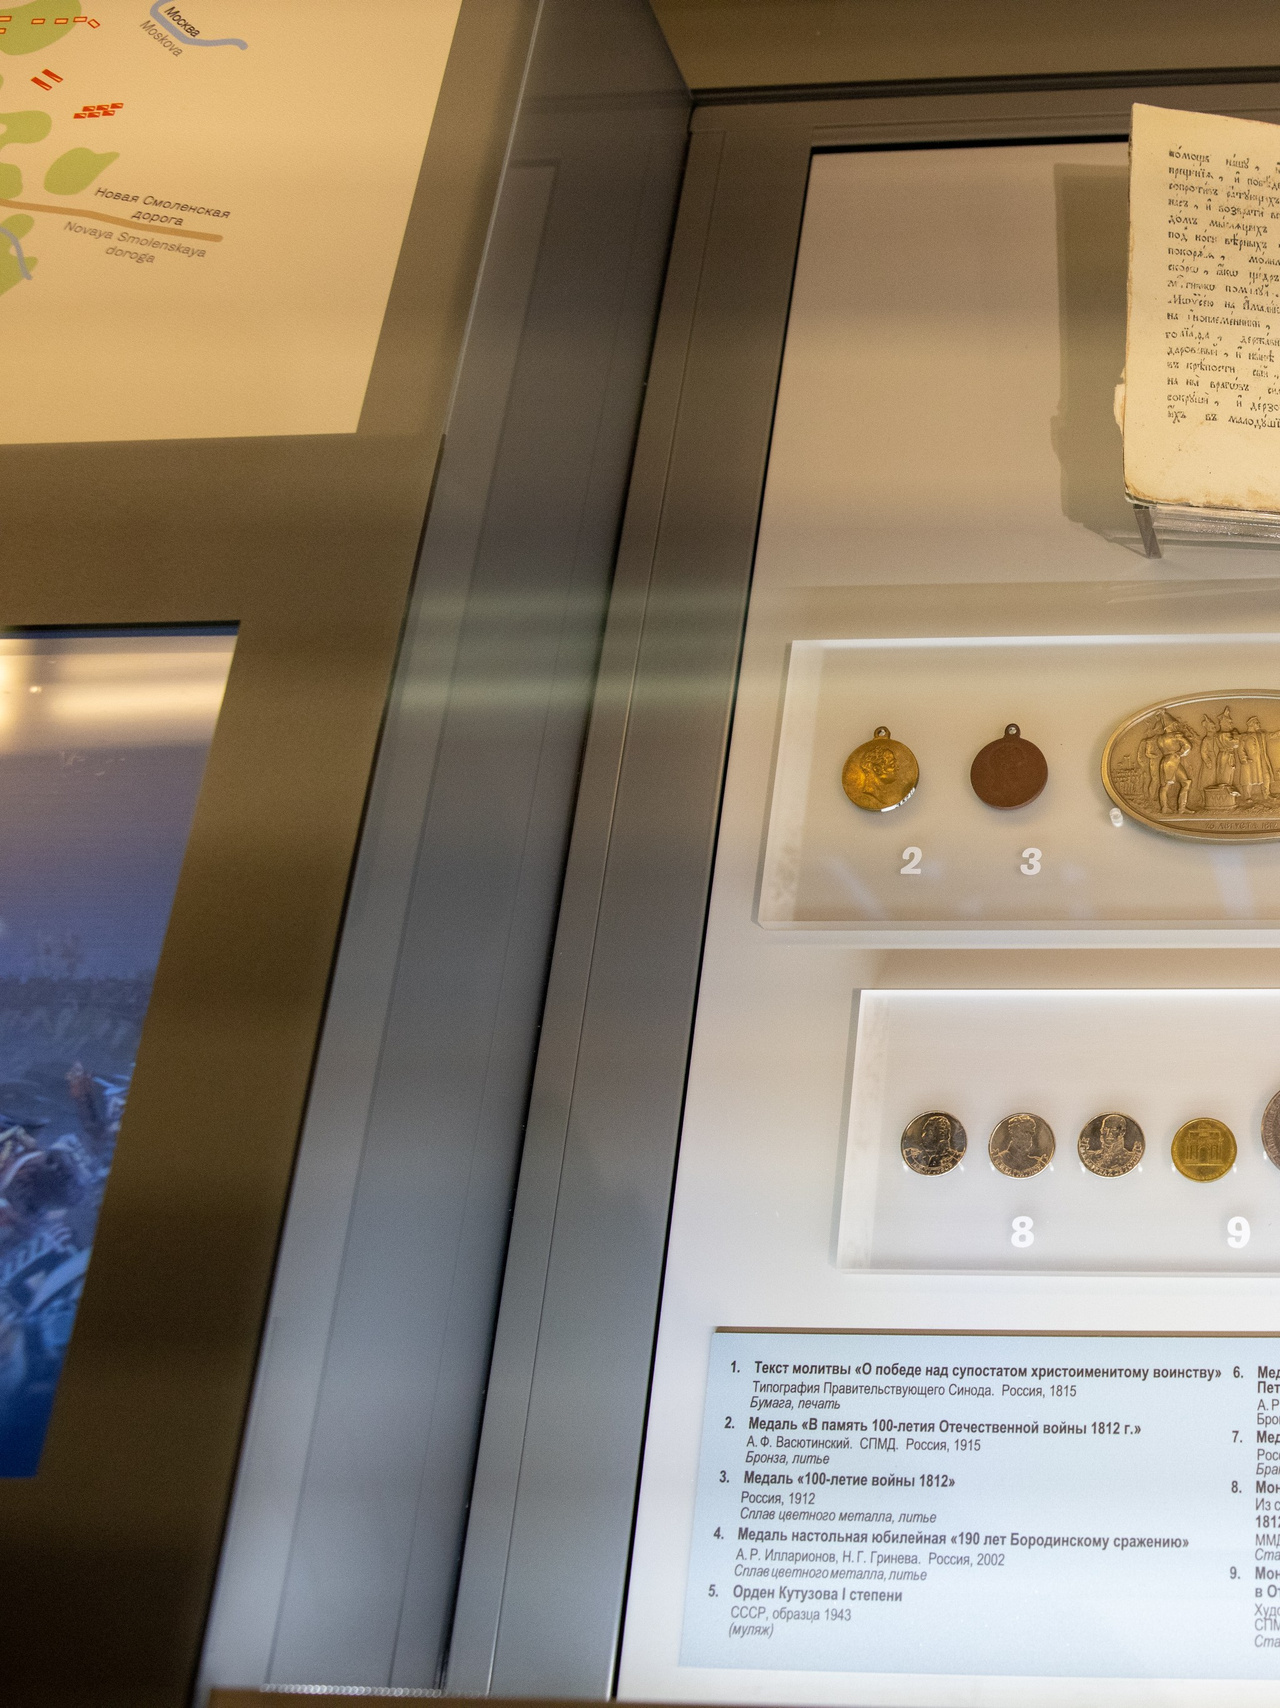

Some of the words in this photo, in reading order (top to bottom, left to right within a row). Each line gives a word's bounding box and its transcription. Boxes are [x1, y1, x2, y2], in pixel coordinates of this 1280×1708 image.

[164, 6, 200, 37] Москва
[140, 20, 182, 57] Moskova
[94, 187, 140, 202] Новая
[143, 195, 231, 219] Смоленская
[131, 210, 184, 226] дорога
[63, 221, 114, 240] Novaya
[117, 231, 207, 258] Smolenskaya
[105, 246, 155, 264] doroga
[901, 847, 922, 874] 2
[1021, 848, 1042, 875] 3
[1011, 1216, 1034, 1248] 8
[1228, 1217, 1250, 1248] 9
[730, 1360, 741, 1373] 1.
[754, 1360, 790, 1374] Текст
[792, 1364, 851, 1375] молитвы
[854, 1362, 872, 1376] «О
[875, 1362, 922, 1378] победе
[925, 1366, 949, 1379] над
[952, 1366, 1028, 1380] супостатом
[1030, 1367, 1150, 1382] христоименитому
[1153, 1368, 1222, 1382] воинству»
[1232, 1365, 1244, 1379] 6.
[752, 1380, 820, 1397] Типография
[823, 1381, 946, 1399] Правительствующего
[948, 1383, 995, 1398] Синода.
[1001, 1383, 1046, 1399] Россия,
[1050, 1384, 1077, 1398] 1815
[749, 1395, 794, 1411] Бумага,
[797, 1399, 841, 1410] печать
[724, 1415, 735, 1429] 2.
[748, 1416, 798, 1432] Медаль
[801, 1417, 818, 1431] «В
[821, 1421, 868, 1432] память
[872, 1418, 935, 1433] 100-летия
[939, 1419, 1039, 1434] Отечественной
[1043, 1421, 1087, 1435] войны
[1091, 1421, 1121, 1435] 1812
[1124, 1424, 1142, 1435] г.»
[719, 1469, 730, 1484] 3.
[743, 1470, 794, 1487] Медаль
[797, 1471, 868, 1486] «100-летие
[871, 1473, 915, 1487] войны
[919, 1473, 956, 1488] 1812»
[1231, 1480, 1242, 1494] 8.
[713, 1526, 724, 1540] 4.
[737, 1526, 788, 1543] Медаль
[791, 1531, 868, 1543] настольная
[871, 1529, 947, 1545] юбилейная
[950, 1531, 980, 1546] «190
[983, 1535, 1007, 1546] лет
[1010, 1532, 1110, 1551] Бородинскому
[1113, 1537, 1190, 1551] сражению»
[1229, 1565, 1241, 1580] 9.
[708, 1583, 719, 1598] 5.
[733, 1584, 775, 1602] Орден
[778, 1585, 839, 1603] Кутузова
[849, 1590, 903, 1602] степени
[1254, 1587, 1263, 1598] в
[730, 1605, 769, 1621] СССР,
[772, 1606, 820, 1624] образца
[824, 1607, 852, 1622] 1943
